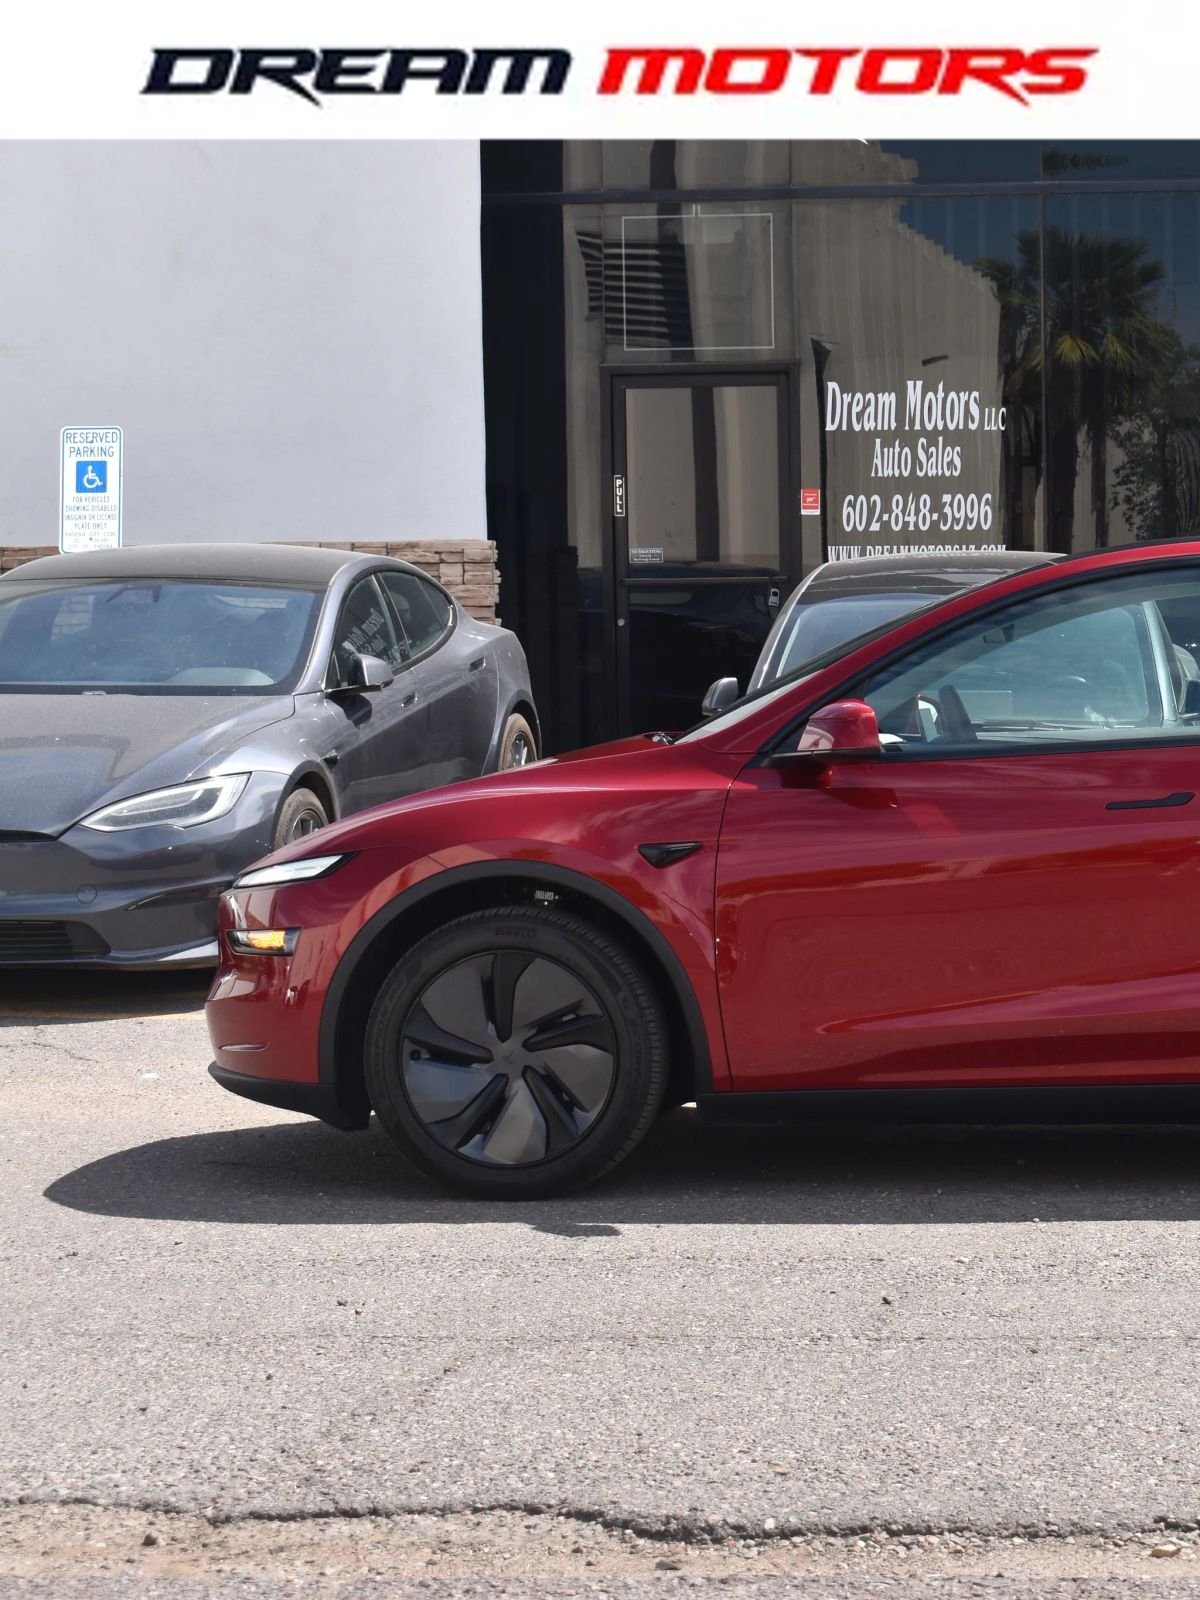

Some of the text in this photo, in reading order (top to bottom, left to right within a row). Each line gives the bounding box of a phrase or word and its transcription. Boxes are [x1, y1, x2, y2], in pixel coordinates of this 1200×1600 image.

[825, 380, 1007, 432] Dream Motors LLC
[65, 431, 118, 444] RESERVED
[69, 446, 115, 458] PARKING
[870, 436, 962, 478] Auto Sales
[72, 495, 110, 503] FOR VEHICLES
[65, 504, 118, 512] SHOWING DISABLED
[842, 491, 993, 532] 602-848-3996
[74, 522, 91, 530] PLATE
